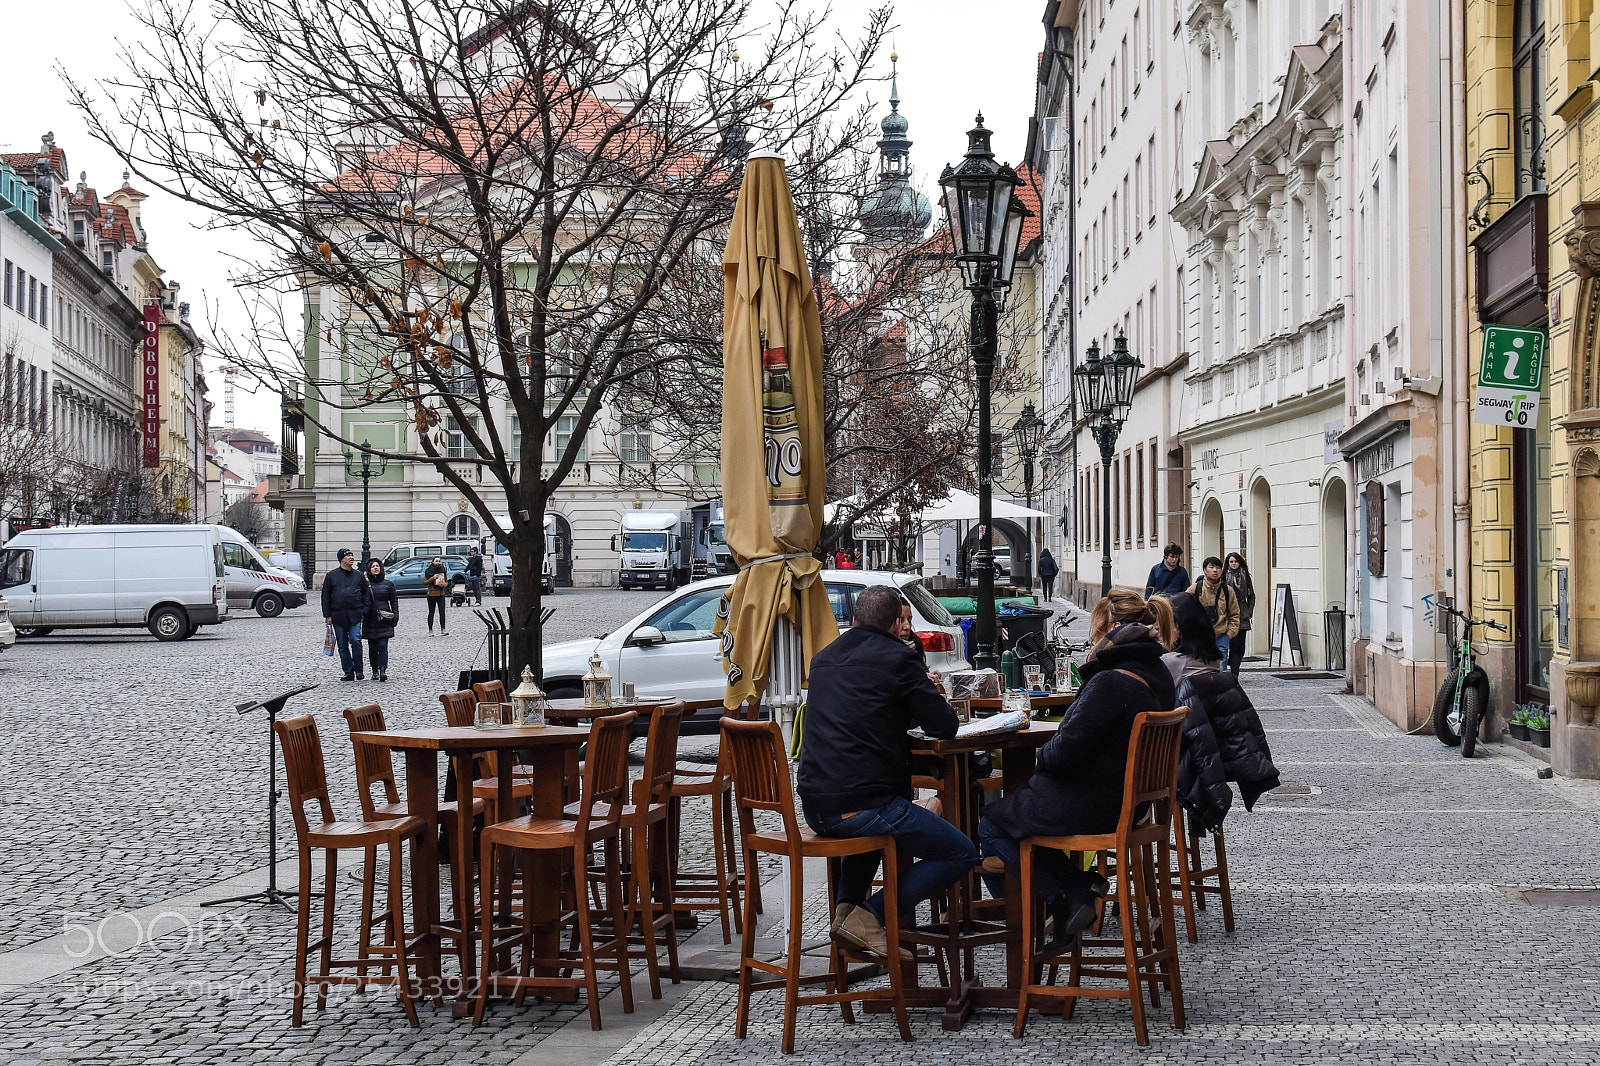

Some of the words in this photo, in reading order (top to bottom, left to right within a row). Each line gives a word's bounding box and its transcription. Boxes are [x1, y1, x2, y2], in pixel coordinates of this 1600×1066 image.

[1485, 331, 1496, 379] PRAHA
[1529, 336, 1540, 384] PRAGUE
[146, 322, 157, 449] DOROTHEUM
[1478, 397, 1514, 409] SEGWAY
